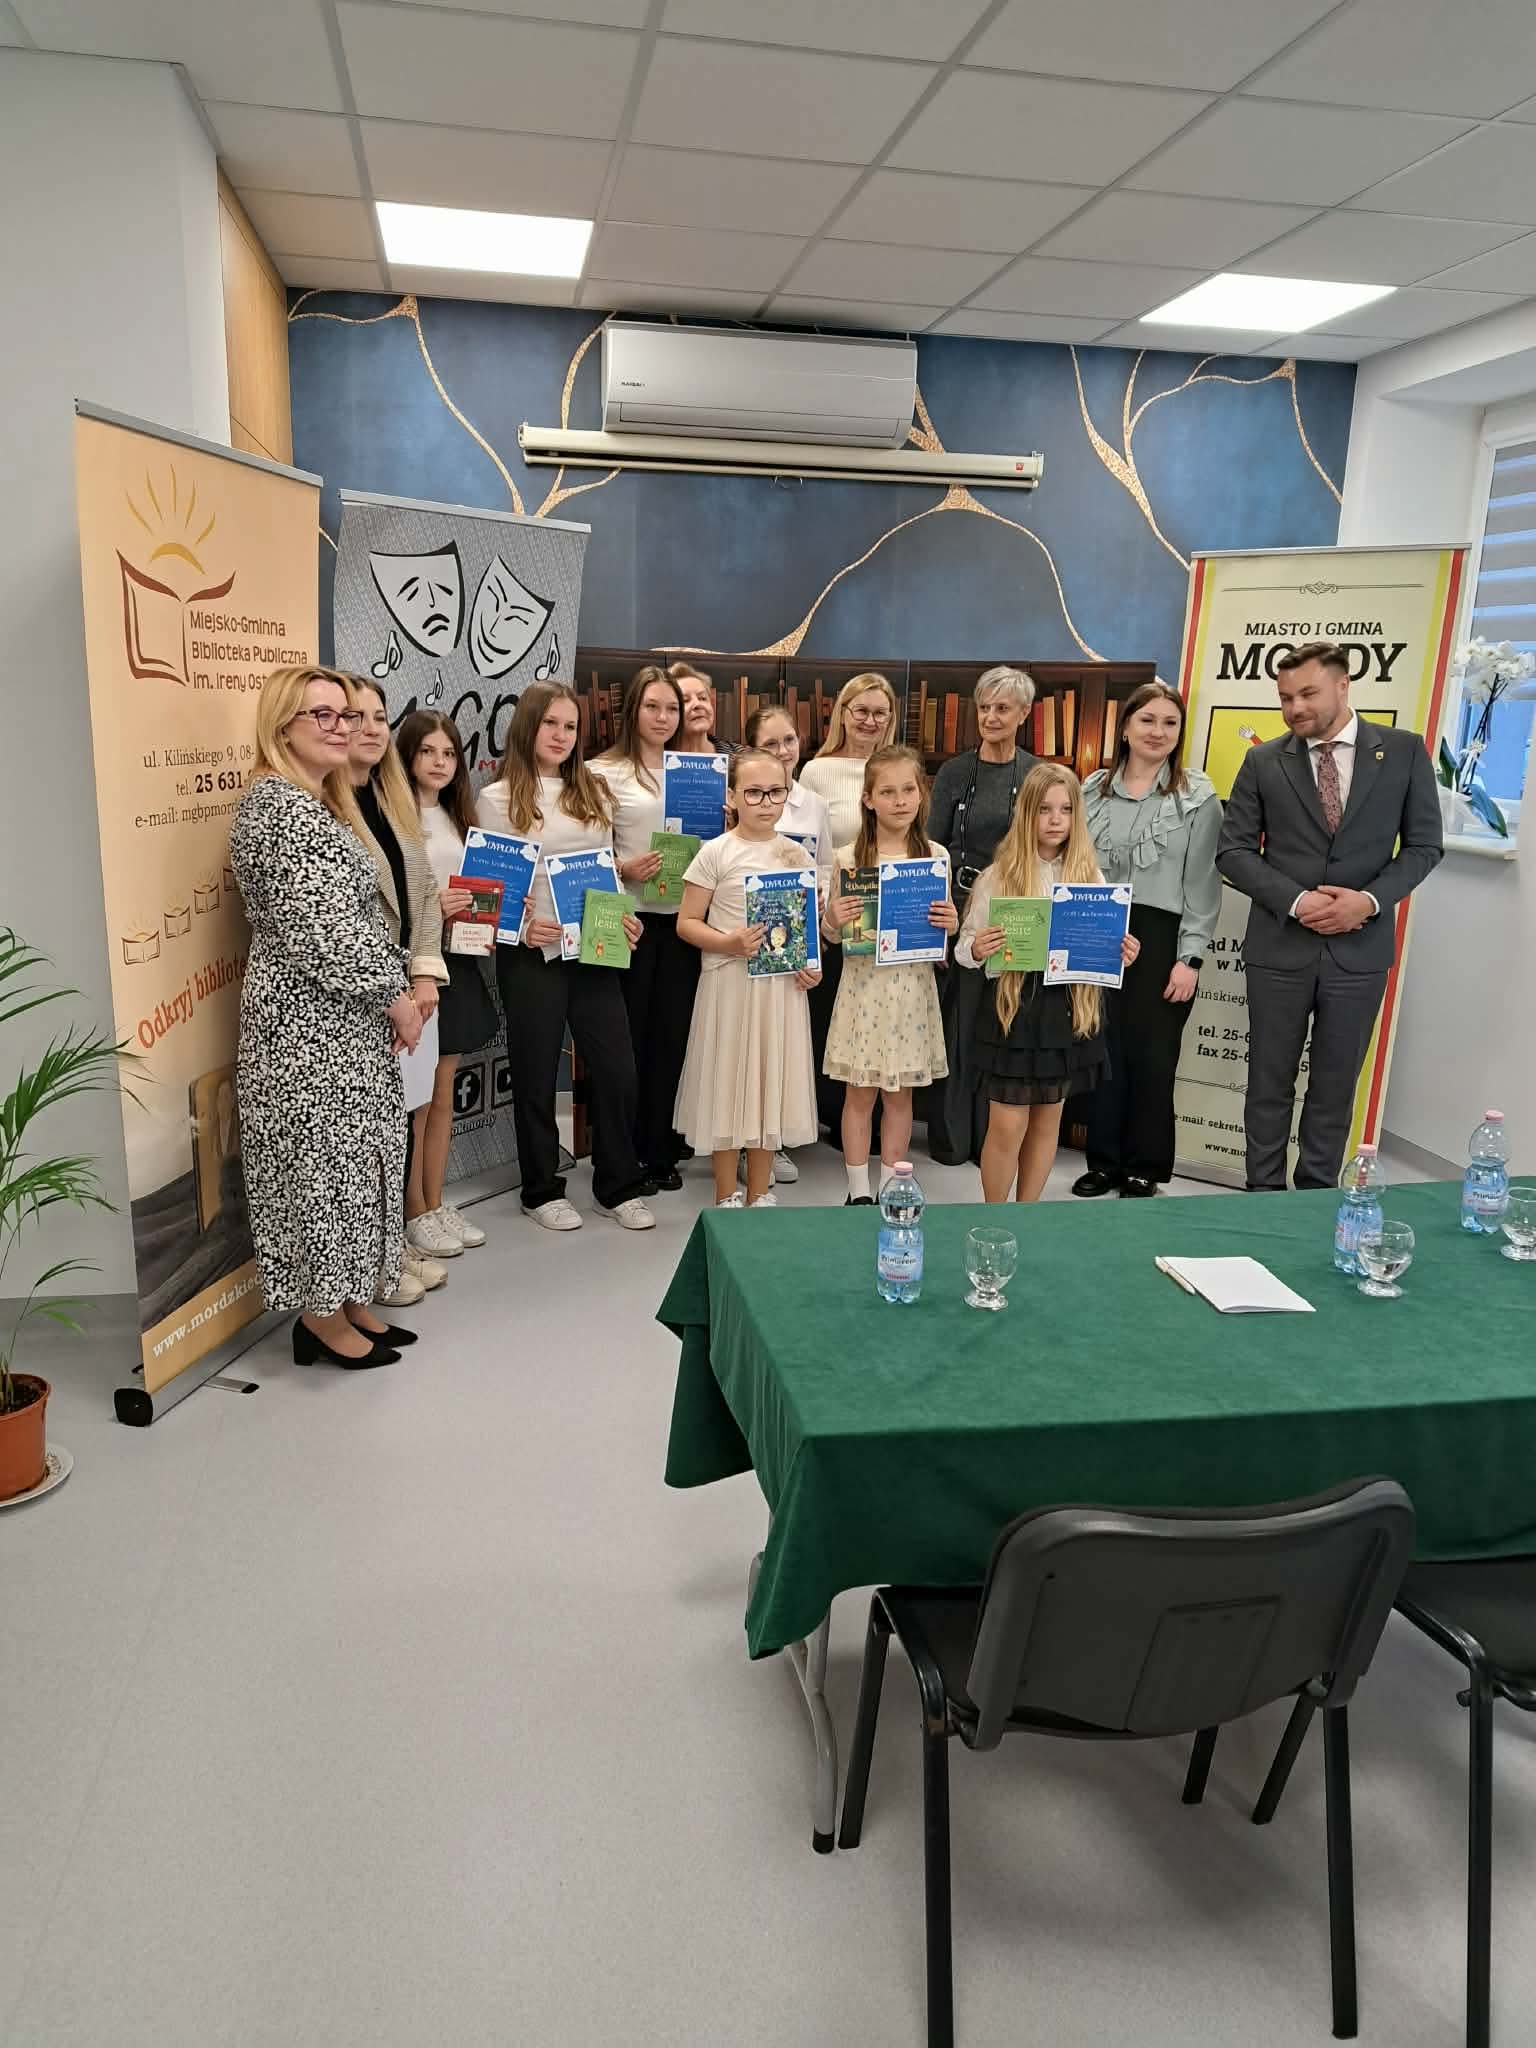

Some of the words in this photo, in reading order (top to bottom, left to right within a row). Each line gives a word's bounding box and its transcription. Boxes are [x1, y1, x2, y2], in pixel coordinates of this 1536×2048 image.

[189, 609, 286, 637] Miejsko-Gminna
[1245, 622, 1311, 636] MIASTO
[1315, 622, 1322, 636] I
[1325, 621, 1384, 636] GMINA
[191, 640, 250, 662] Biblioteka
[253, 645, 308, 665] Publiczna
[1216, 642, 1407, 683] MODY
[143, 750, 161, 768] ul.
[164, 746, 224, 767] Kilińskiego
[682, 758, 711, 771] DYPLOM
[175, 778, 192, 797] tel.
[194, 772, 213, 794] 25
[134, 805, 179, 828] e-mail:
[486, 839, 520, 856] DYPLOM
[899, 867, 929, 878] DYPLOM
[764, 878, 797, 889] DYPLOM
[1073, 892, 1110, 902] DYPLOM
[138, 978, 194, 1048] Odkryj
[1197, 1025, 1218, 1039] tel.
[1196, 1043, 1219, 1058] fax
